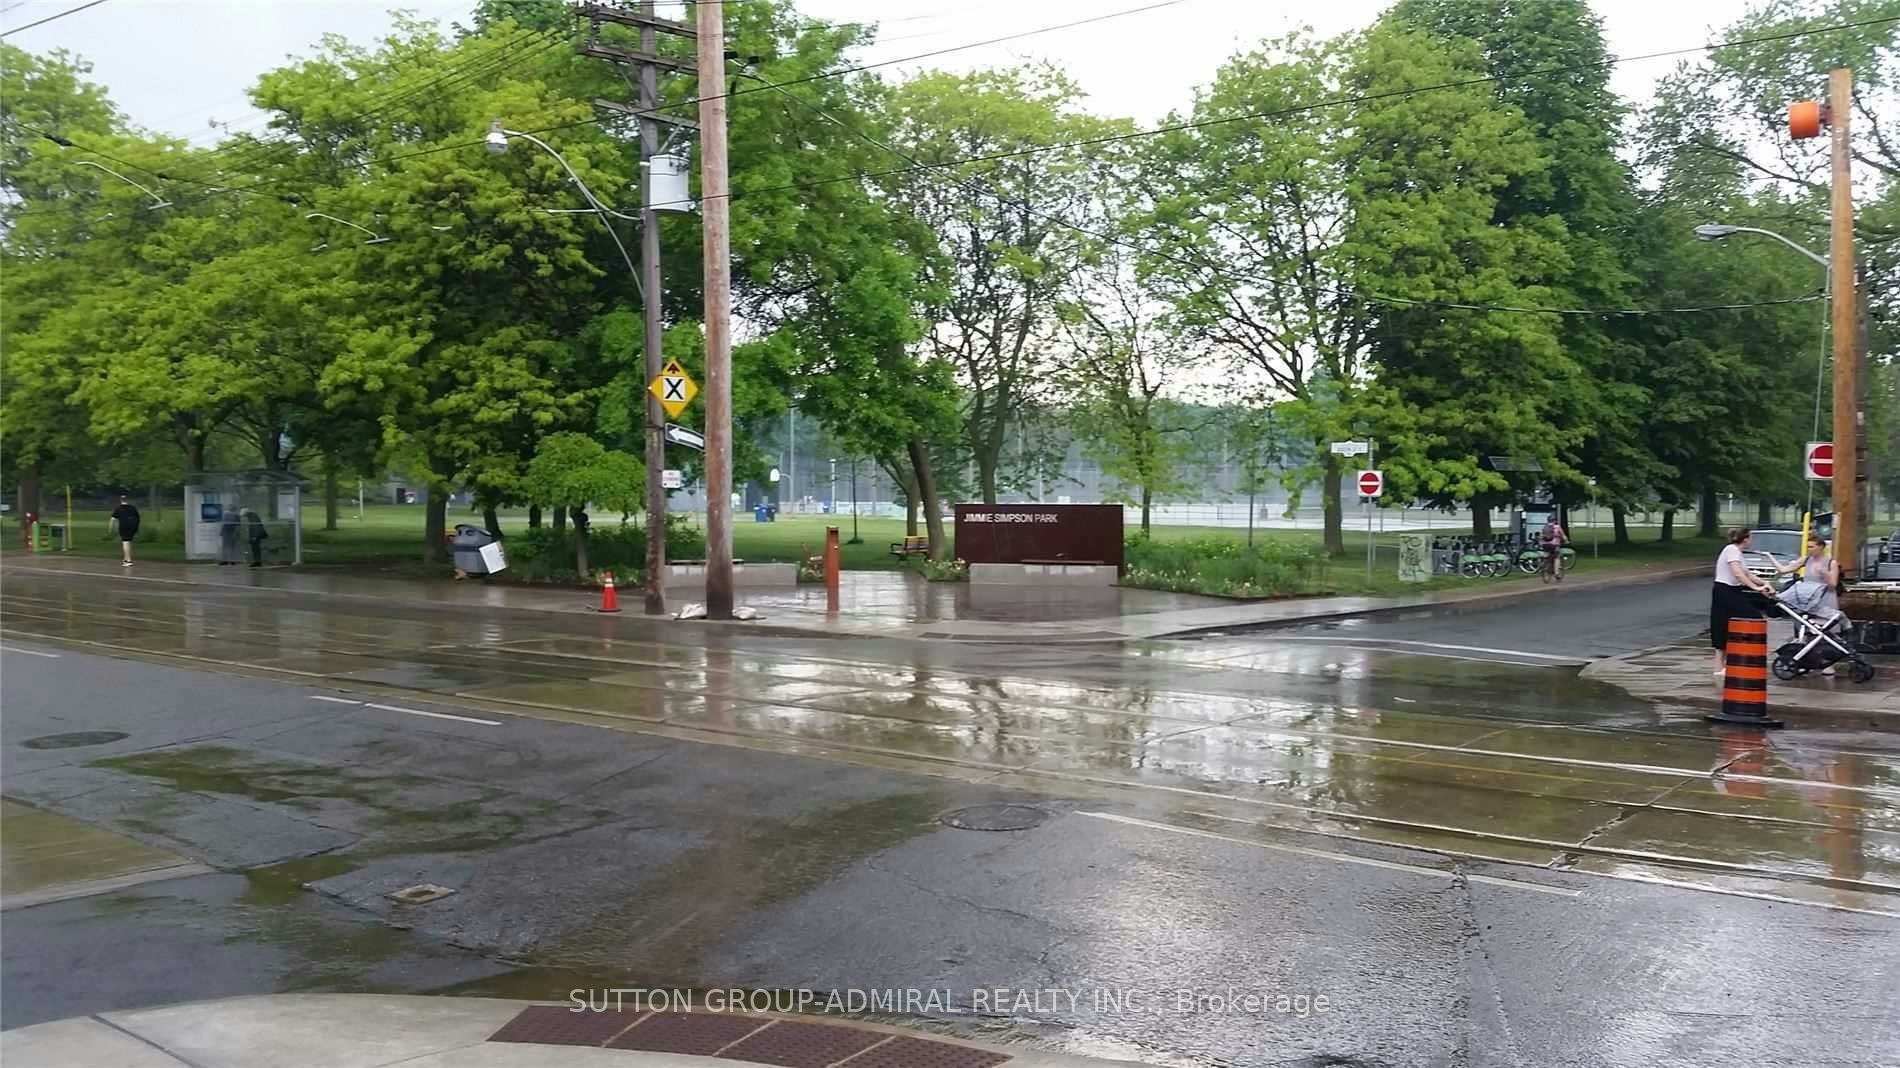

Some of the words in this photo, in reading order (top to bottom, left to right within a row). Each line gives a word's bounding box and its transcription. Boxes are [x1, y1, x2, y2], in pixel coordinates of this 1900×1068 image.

[964, 513, 993, 523] JIMMIE
[994, 513, 1033, 523] SIMPSON
[1035, 513, 1058, 523] PARK
